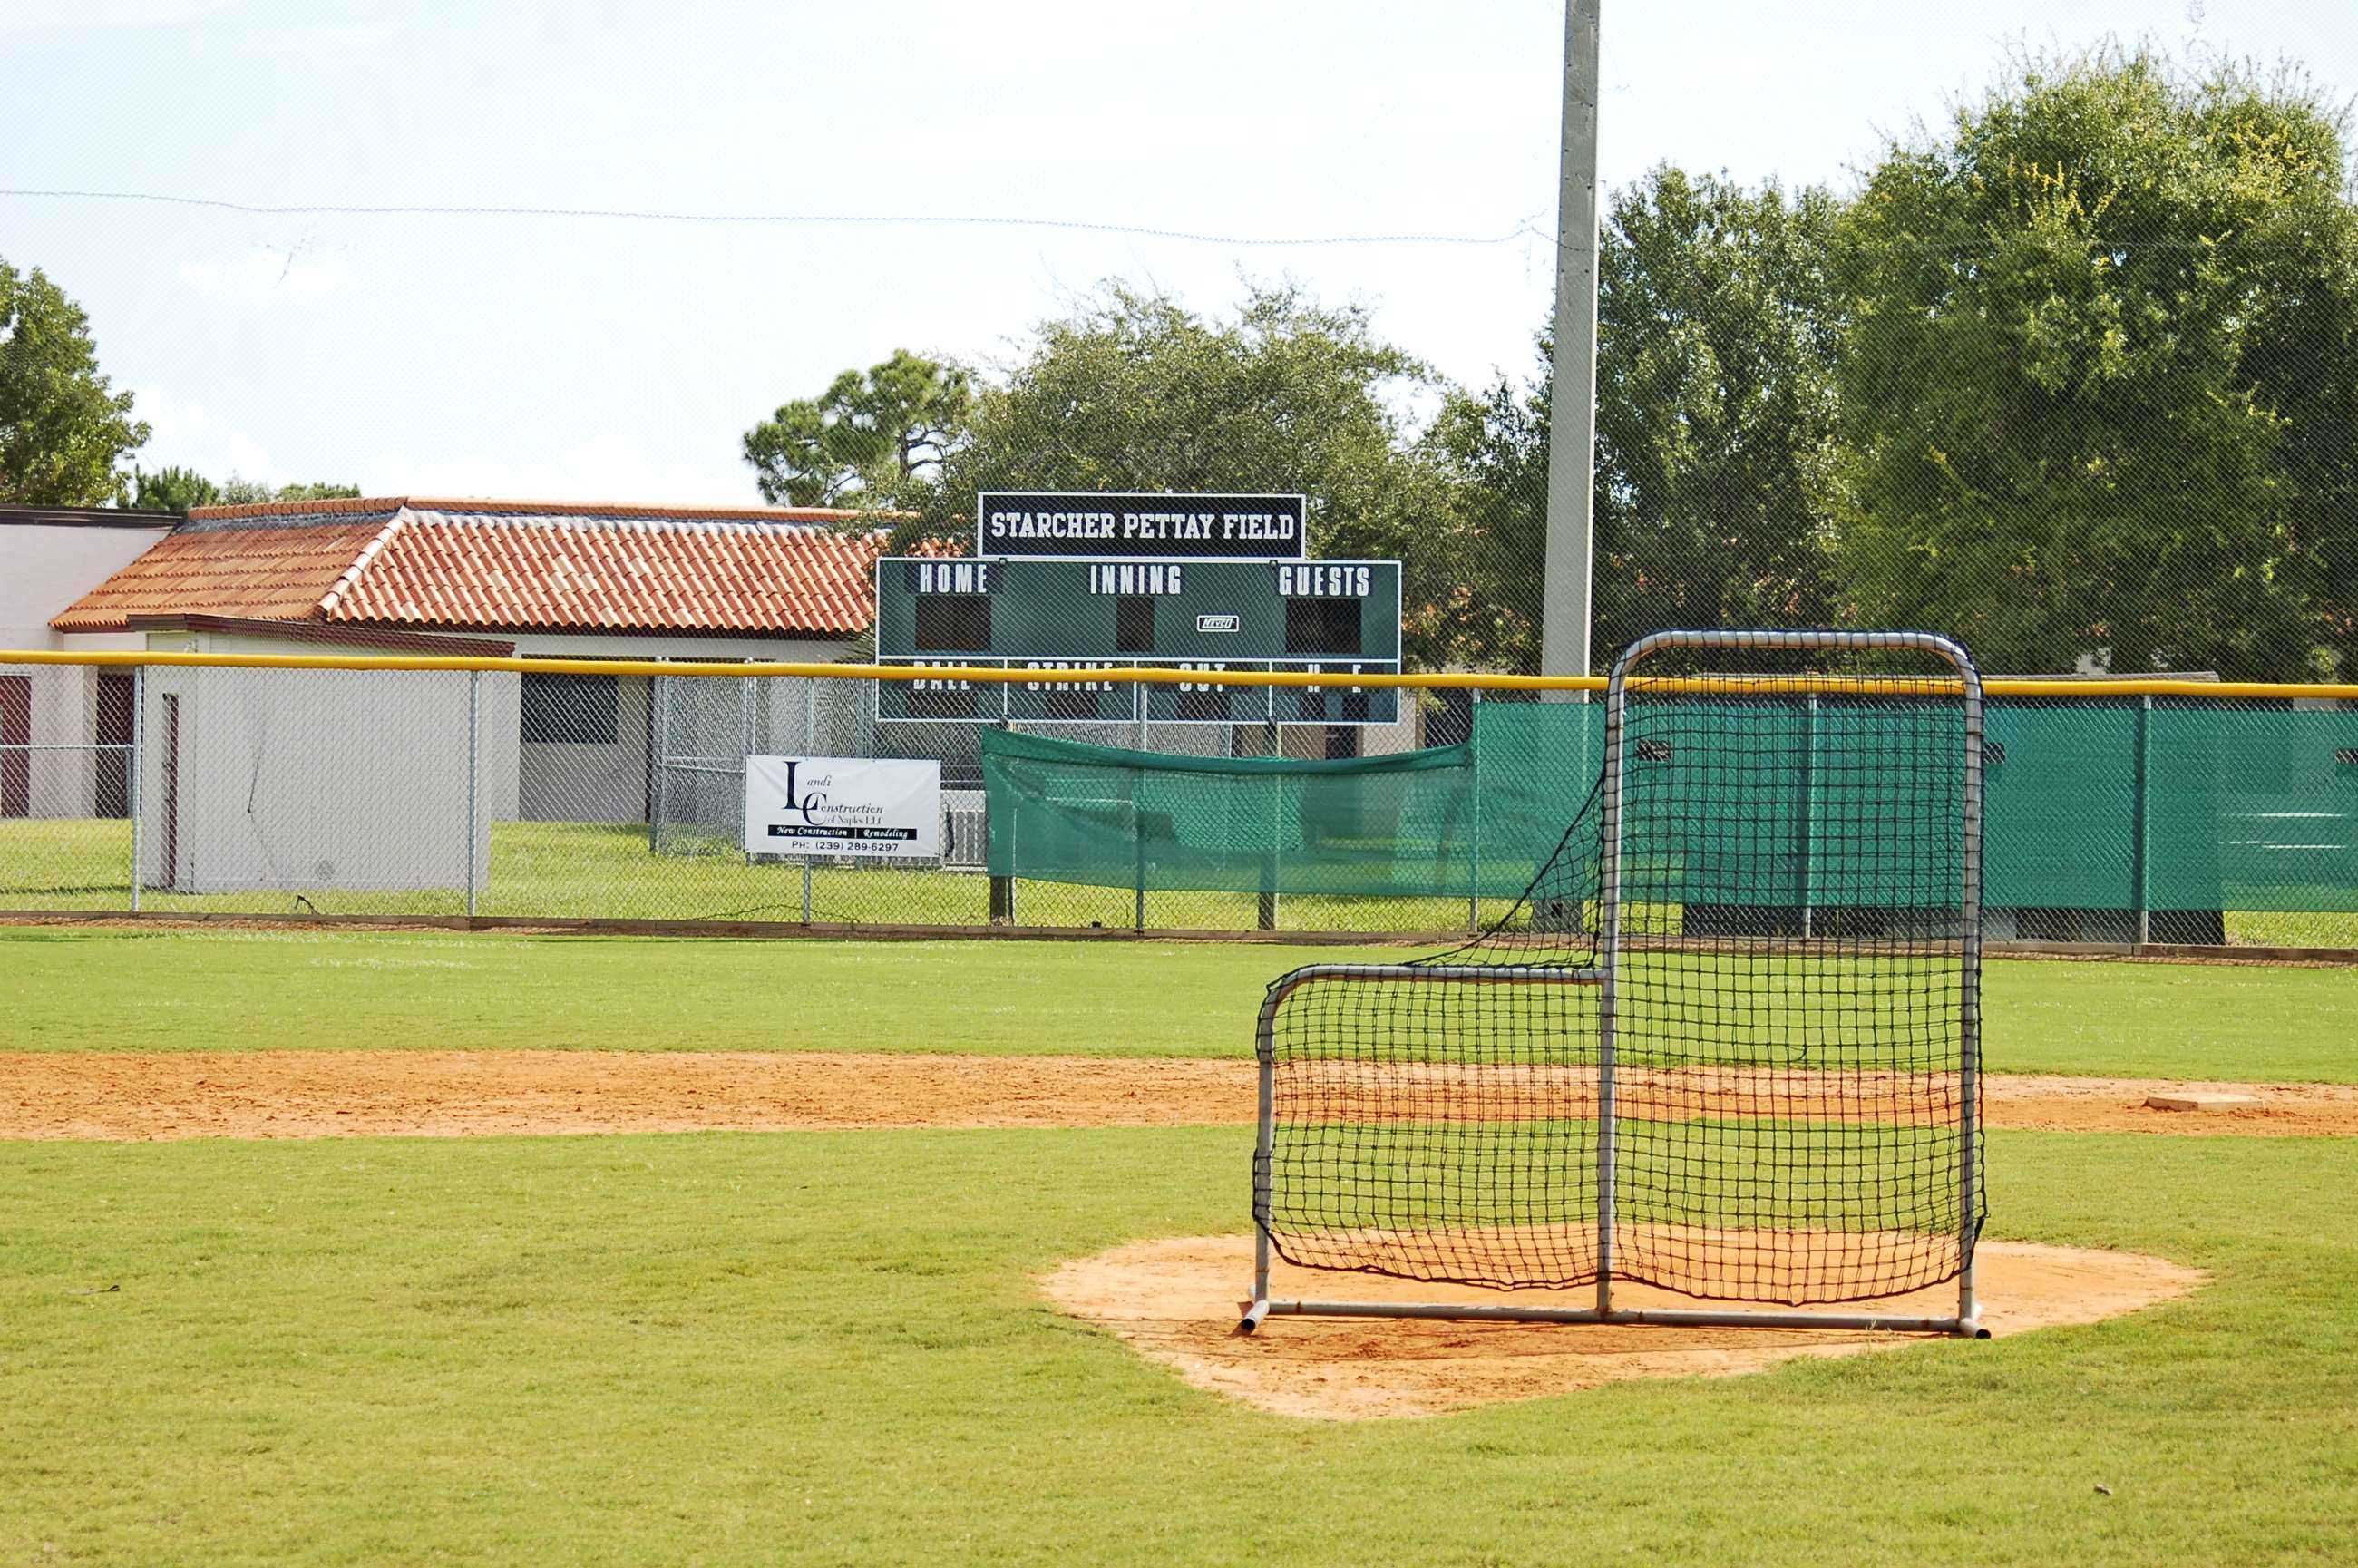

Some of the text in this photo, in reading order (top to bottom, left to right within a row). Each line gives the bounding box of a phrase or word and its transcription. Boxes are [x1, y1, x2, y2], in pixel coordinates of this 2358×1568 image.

[991, 512, 1294, 540] STARCHER PETTAY FIELD
[919, 564, 987, 594] HOME
[1090, 566, 1182, 595] INNING
[1278, 566, 1369, 597] GUESTS
[776, 826, 909, 840] New Construction Remodeling
[815, 841, 843, 851] (239)
[847, 842, 900, 852] 289-6297
